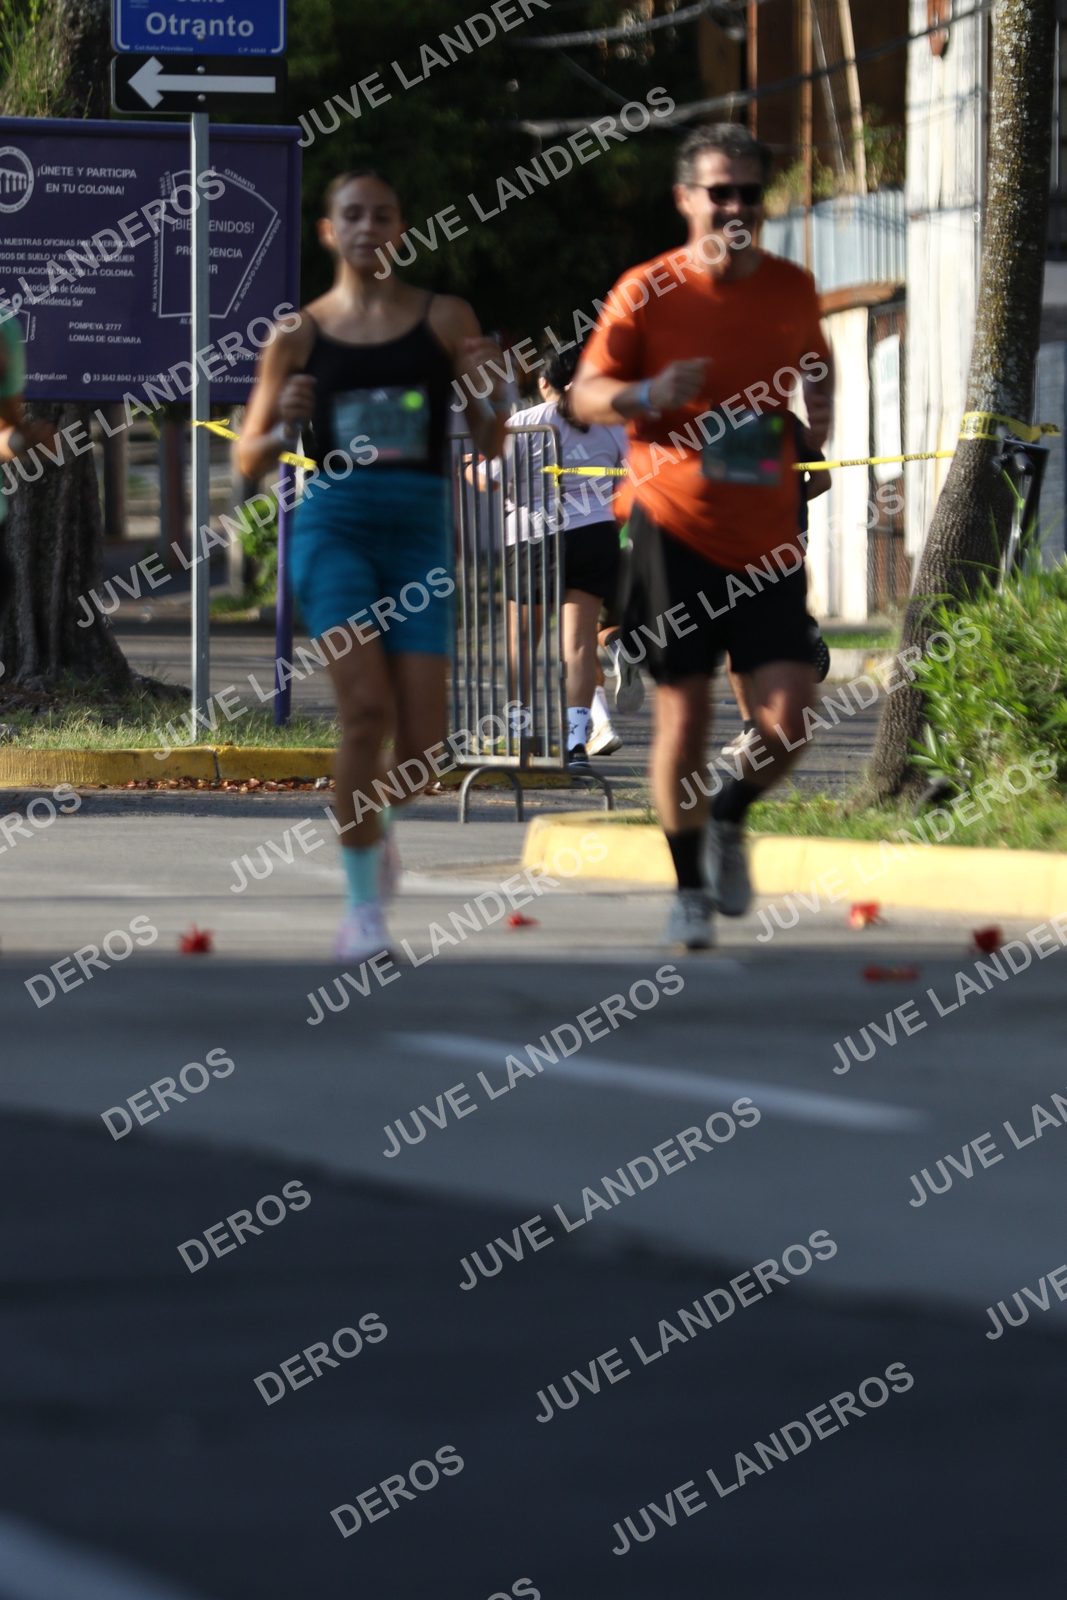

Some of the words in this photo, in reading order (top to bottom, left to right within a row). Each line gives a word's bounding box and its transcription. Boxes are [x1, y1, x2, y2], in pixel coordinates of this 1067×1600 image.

[146, 12, 254, 37] Otranto
[37, 165, 74, 176] ¡ÚNETE
[77, 167, 84, 176] Y
[86, 168, 136, 178] PARTICIPA
[224, 168, 256, 190] OTRANTO
[46, 183, 60, 192] EN
[62, 184, 76, 194] TU
[78, 184, 125, 196] COLONIA!
[172, 218, 254, 234] ¡BIEENIDOS!
[4, 238, 42, 246] NUESTRAS
[43, 238, 75, 246] OFICINAS
[16, 252, 26, 260] DE
[27, 252, 50, 260] SUELO
[176, 246, 243, 258] PRDENCIA
[60, 284, 69, 292] de
[70, 284, 96, 294] Colonos
[240, 271, 256, 299] ADOLFO
[72, 298, 84, 306] Sur
[69, 321, 104, 330] POMPEYA
[105, 323, 122, 331] 2777
[69, 334, 95, 342] LOMAS
[107, 336, 141, 344] GUEVARA
[137, 374, 144, 382] 33
